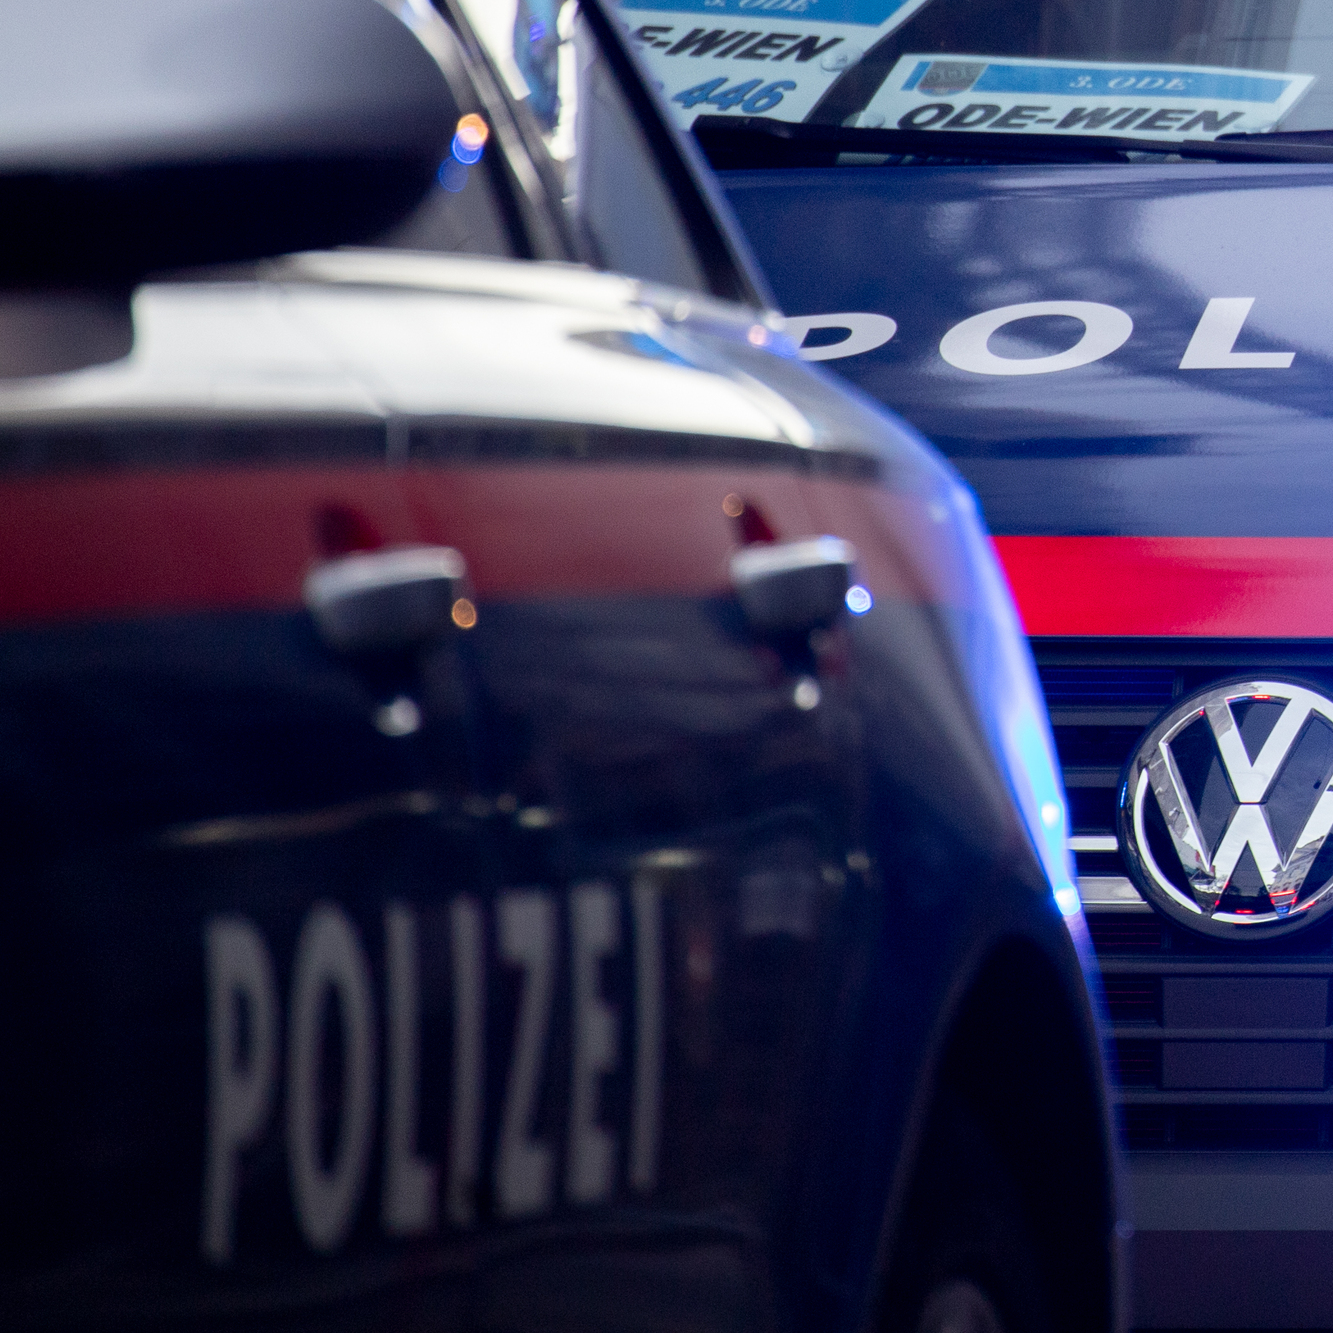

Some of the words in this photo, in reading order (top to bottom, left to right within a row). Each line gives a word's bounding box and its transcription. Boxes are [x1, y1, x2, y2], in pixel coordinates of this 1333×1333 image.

[671, 76, 797, 113] 446
[1069, 75, 1093, 89] 3.
[1107, 77, 1194, 91] ODE
[897, 103, 1245, 133] ODE-WIEN
[204, 876, 664, 1260] POLIZEI
